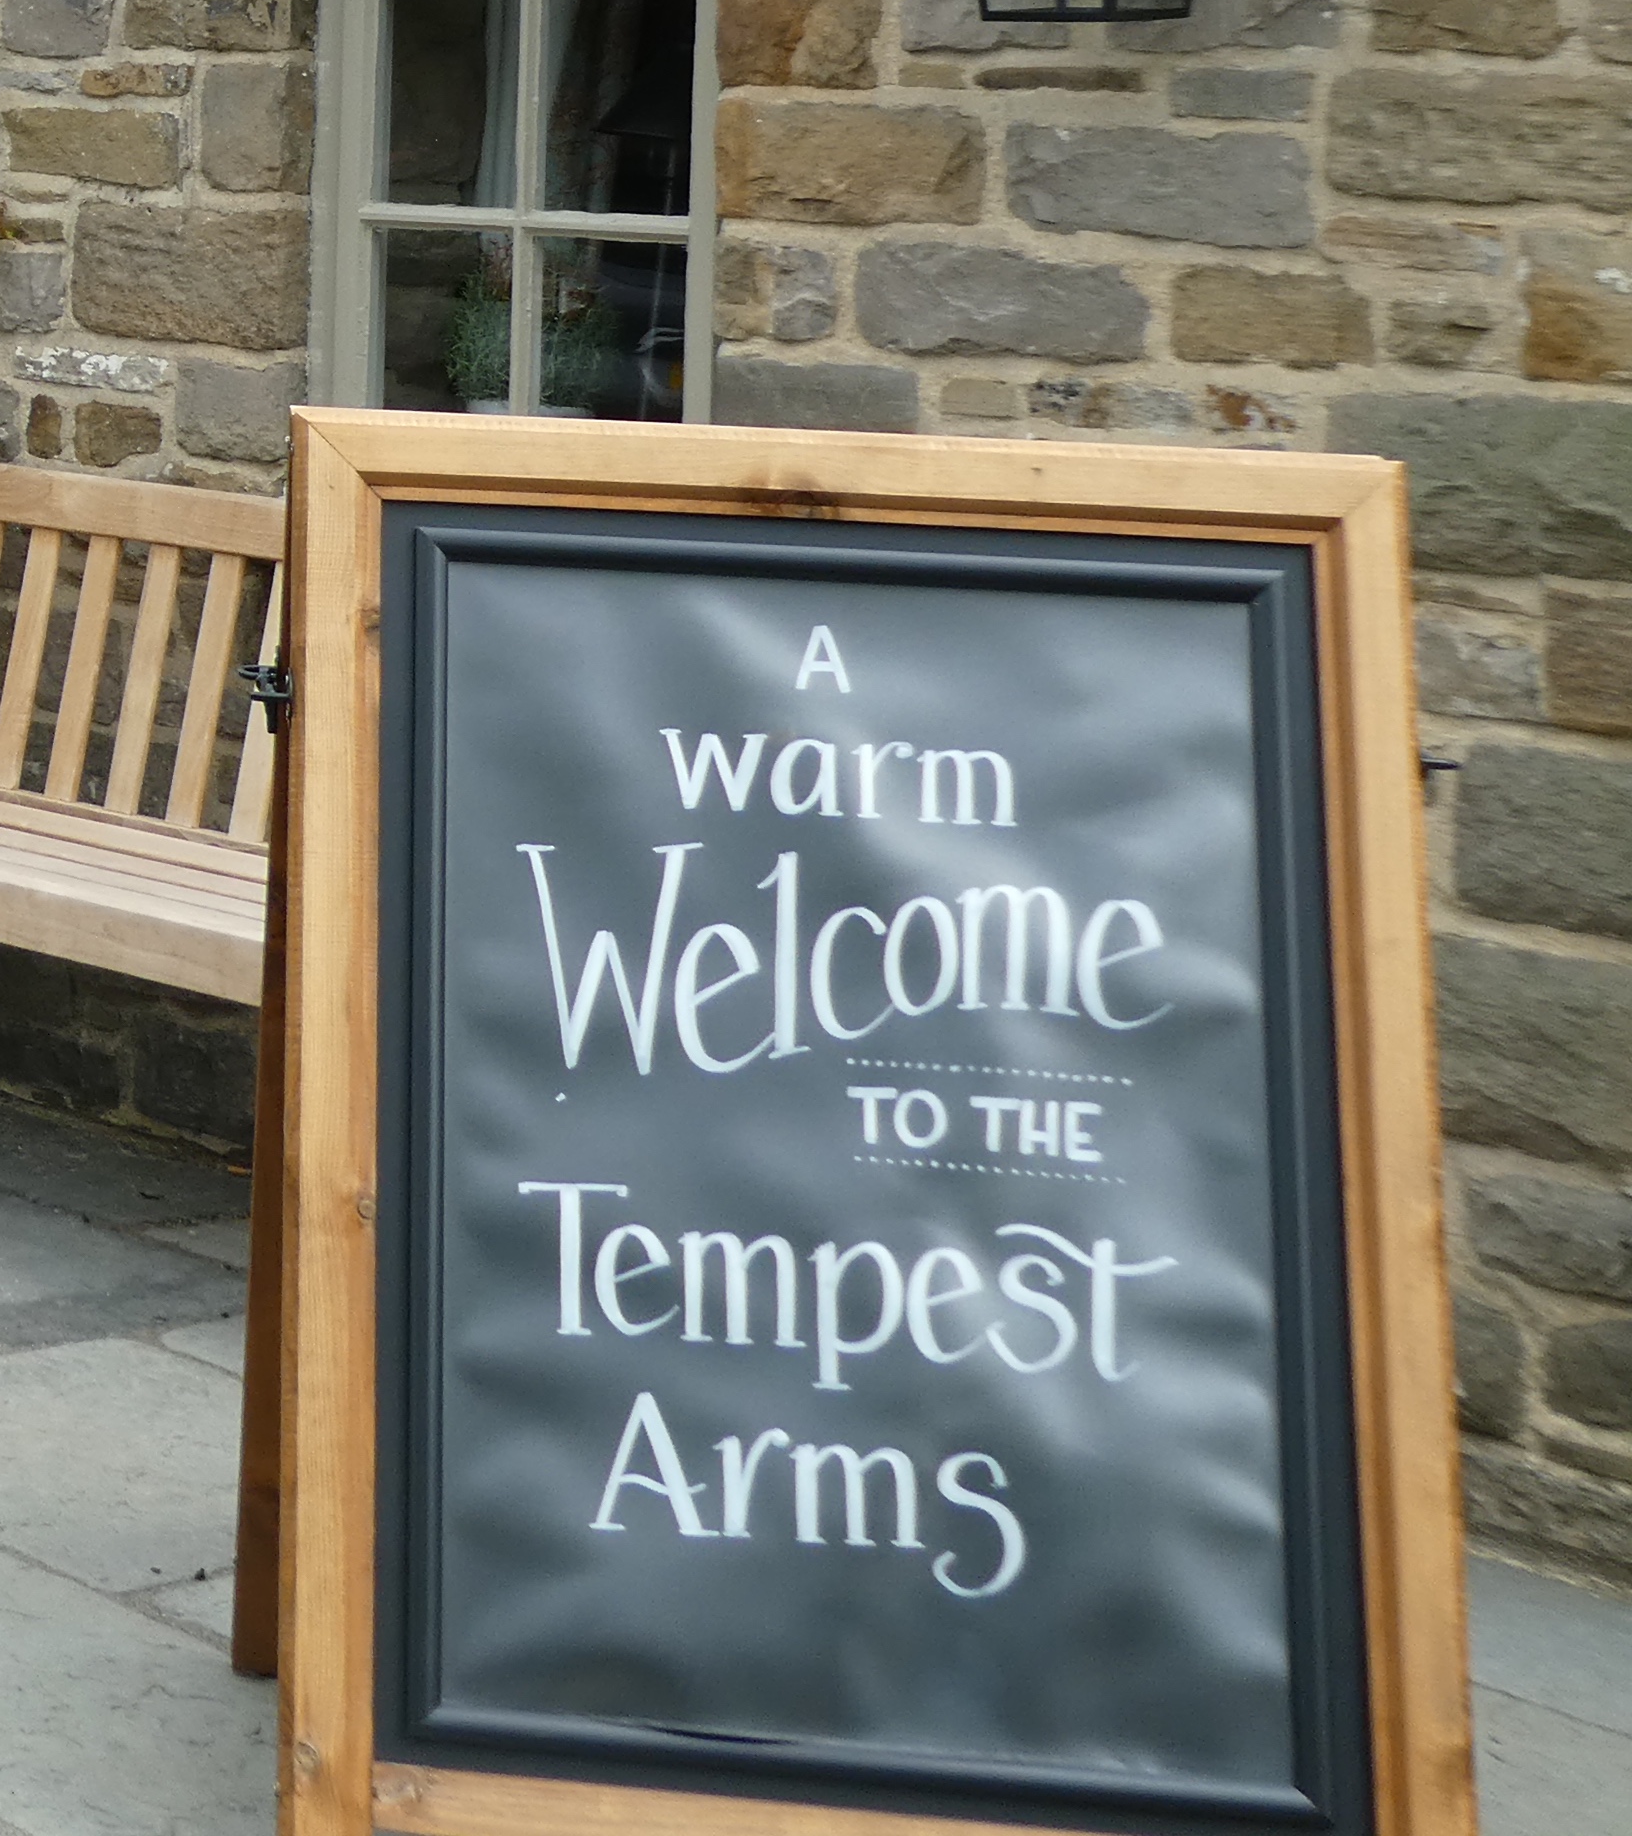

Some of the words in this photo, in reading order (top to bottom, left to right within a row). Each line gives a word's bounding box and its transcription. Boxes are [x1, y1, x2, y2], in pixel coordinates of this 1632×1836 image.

[794, 624, 852, 694] A
[659, 726, 1019, 828] warm
[517, 841, 1179, 1075] Welcome
[846, 1084, 948, 1149] TO
[970, 1095, 1103, 1163] THE
[518, 1180, 1177, 1391] Tempest
[588, 1391, 1028, 1598] Arms
